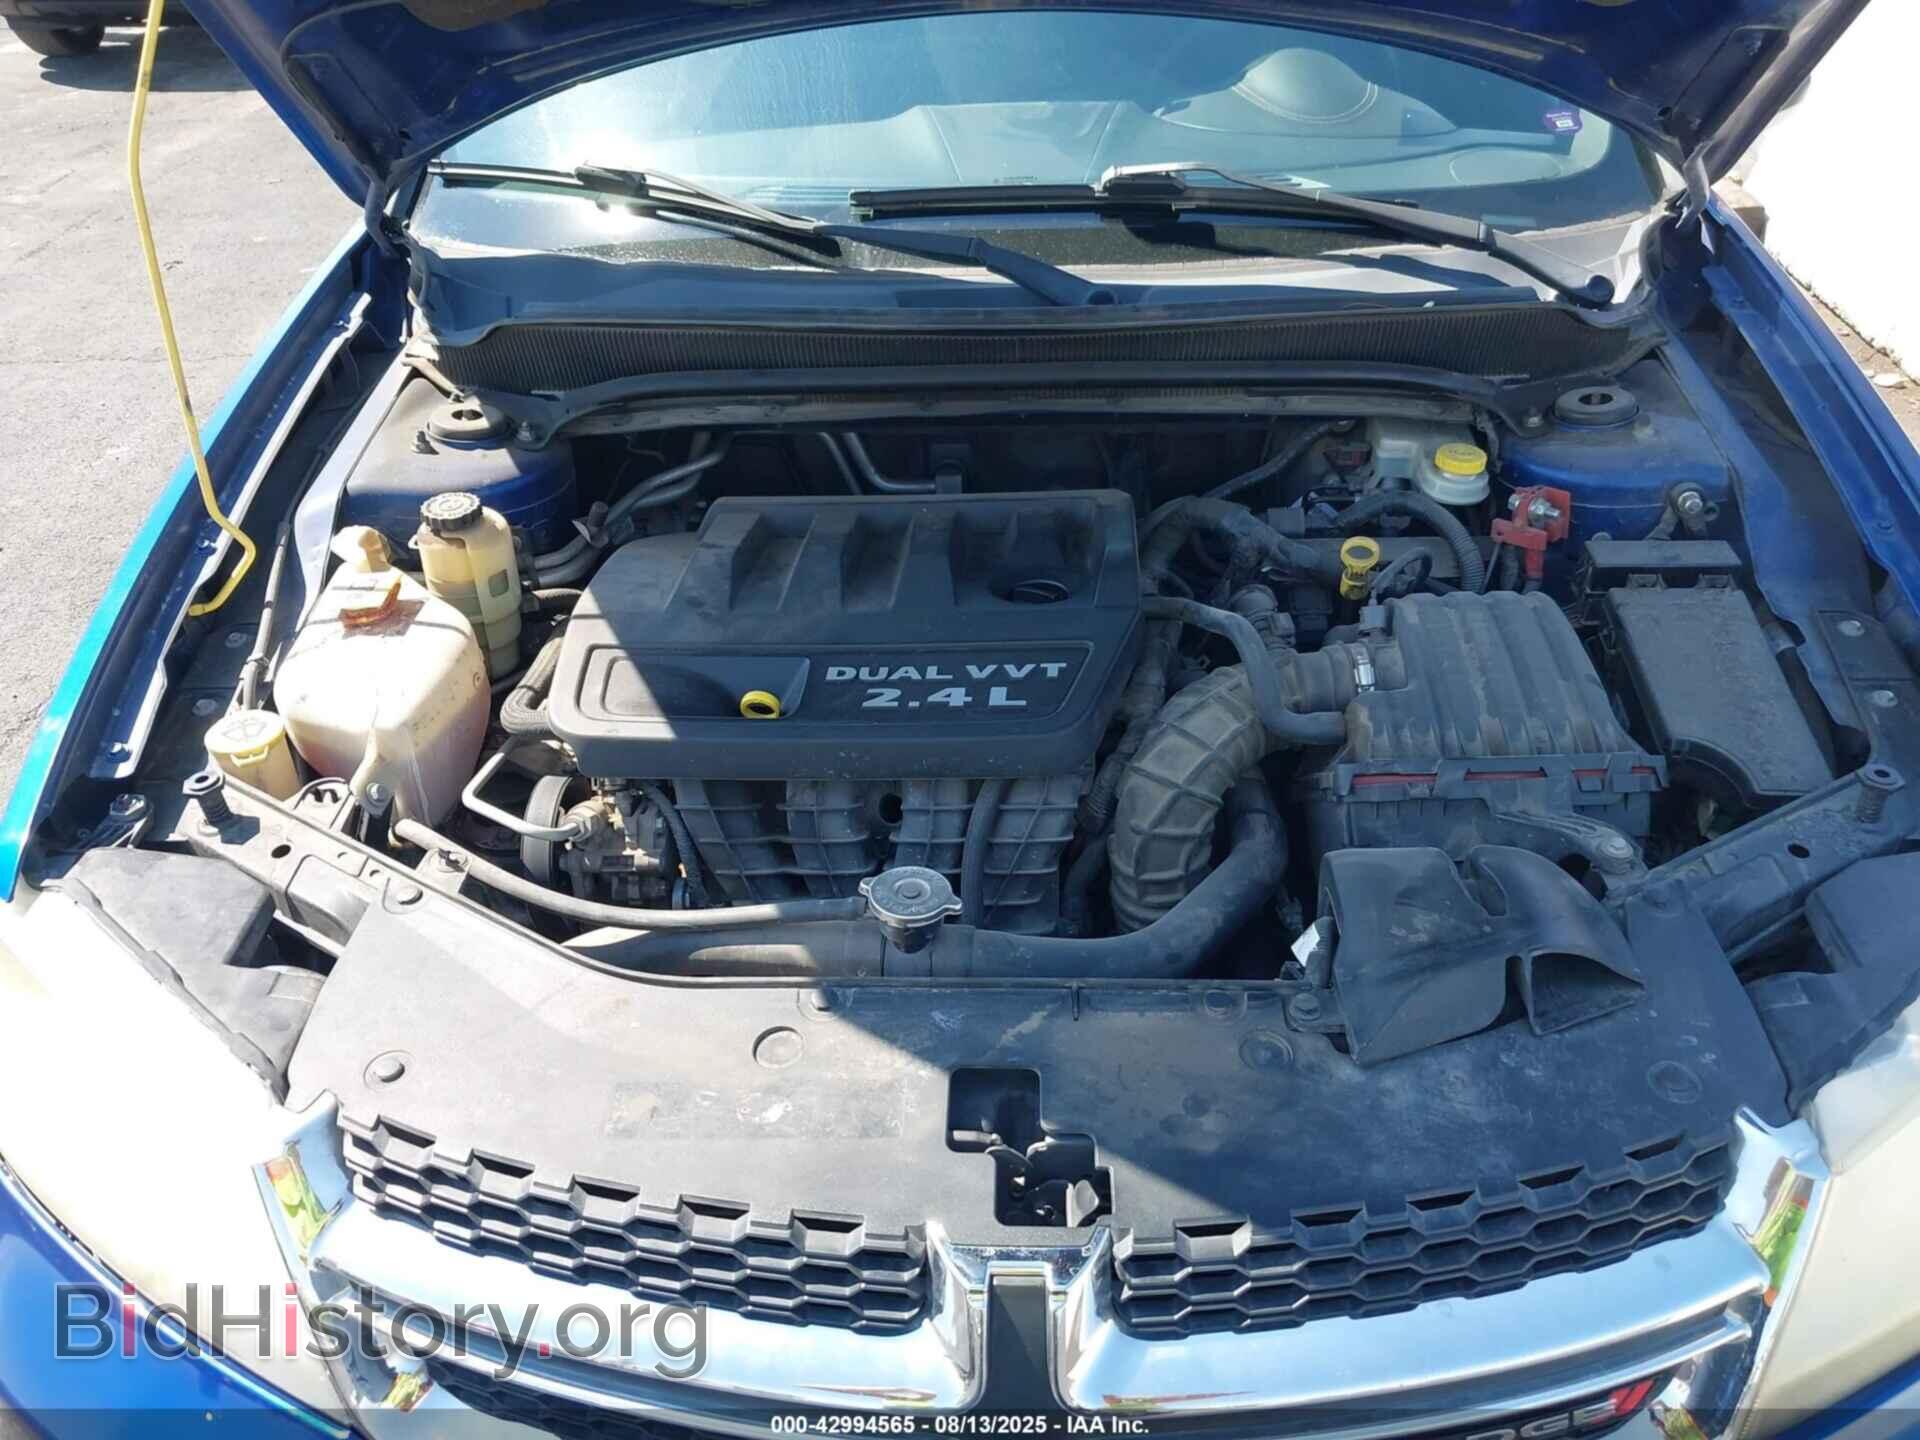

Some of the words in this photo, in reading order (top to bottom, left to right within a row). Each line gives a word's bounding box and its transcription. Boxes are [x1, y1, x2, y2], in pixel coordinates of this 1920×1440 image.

[825, 666, 953, 681] DUAL
[965, 662, 1067, 679] VVT
[861, 687, 972, 708] 2.4
[988, 686, 1027, 706] L
